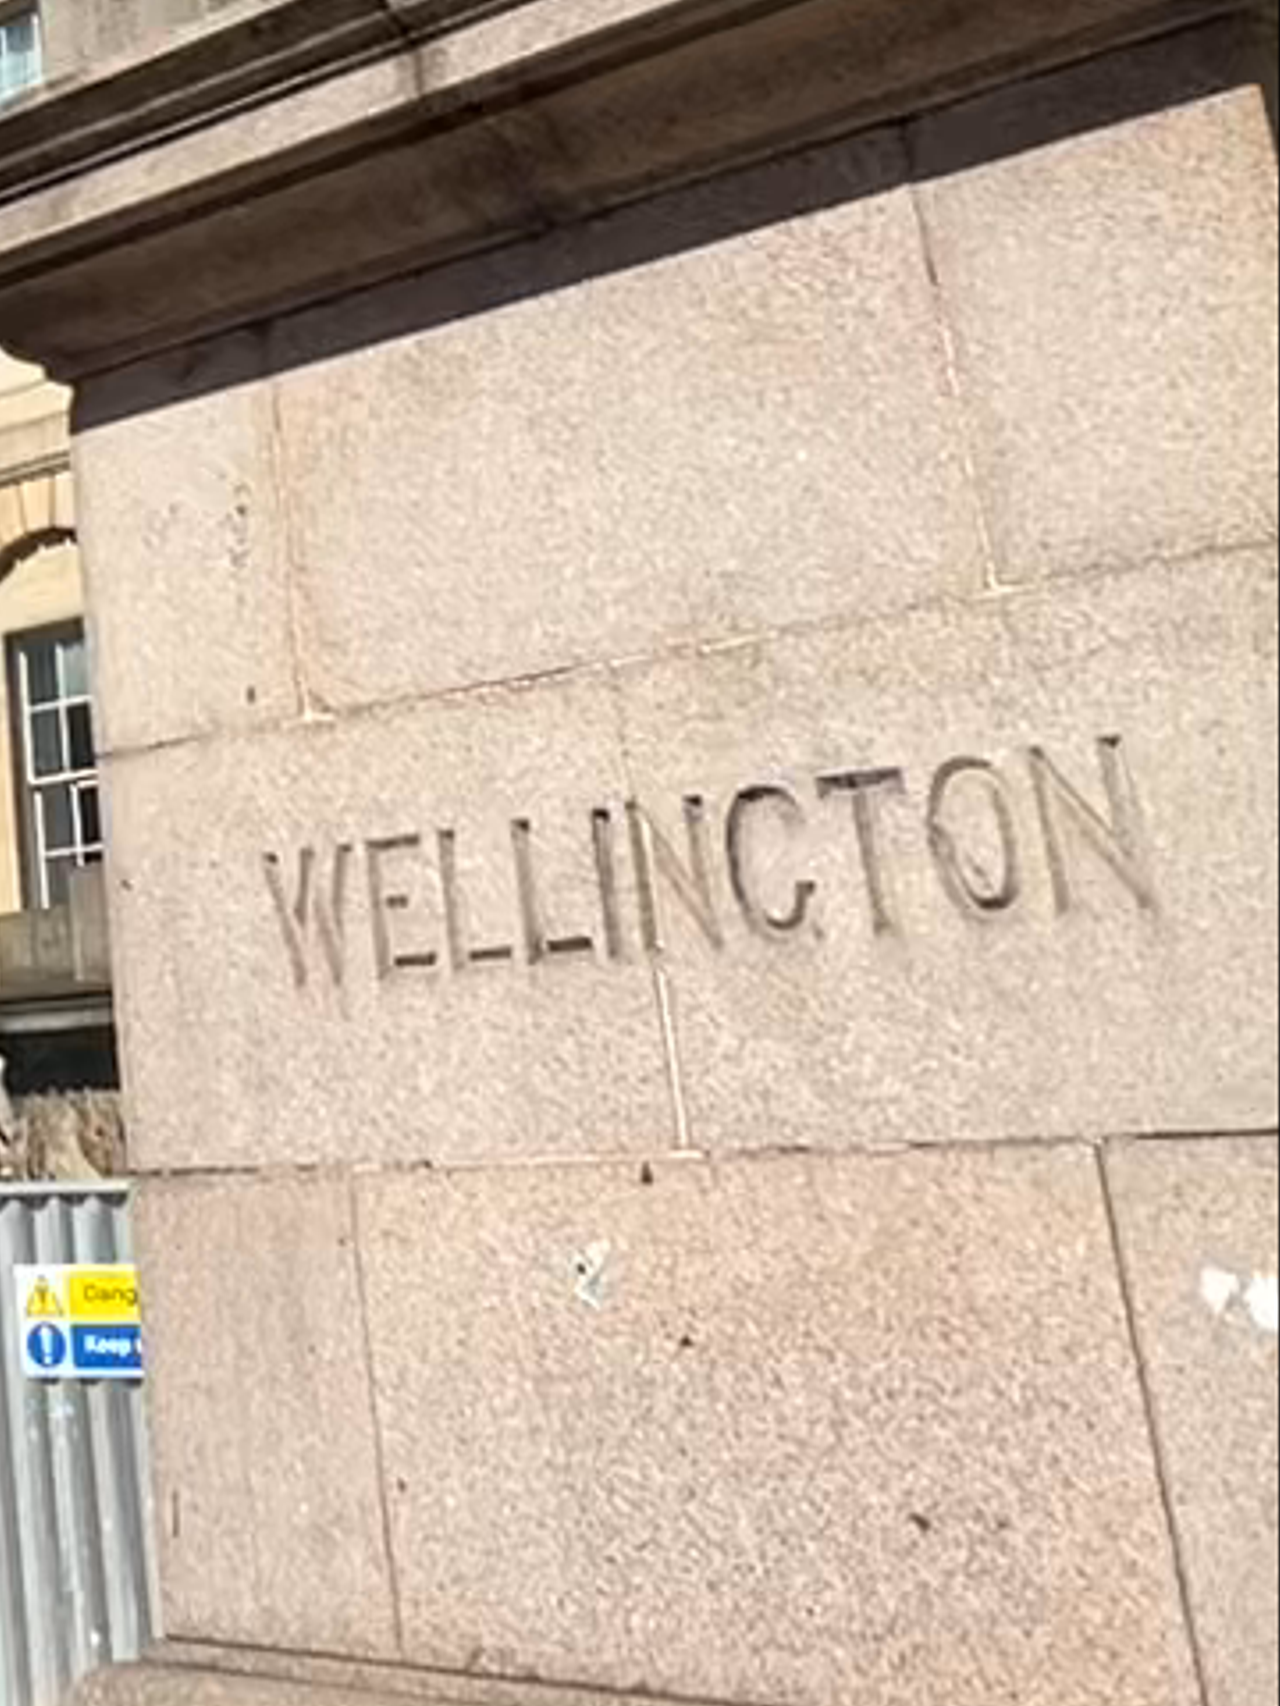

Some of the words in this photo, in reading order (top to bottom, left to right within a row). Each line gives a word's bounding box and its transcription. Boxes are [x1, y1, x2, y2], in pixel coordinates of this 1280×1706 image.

[262, 734, 1158, 990] WELLINGTON
[83, 1284, 138, 1306] Dang
[83, 1334, 131, 1357] Keep
